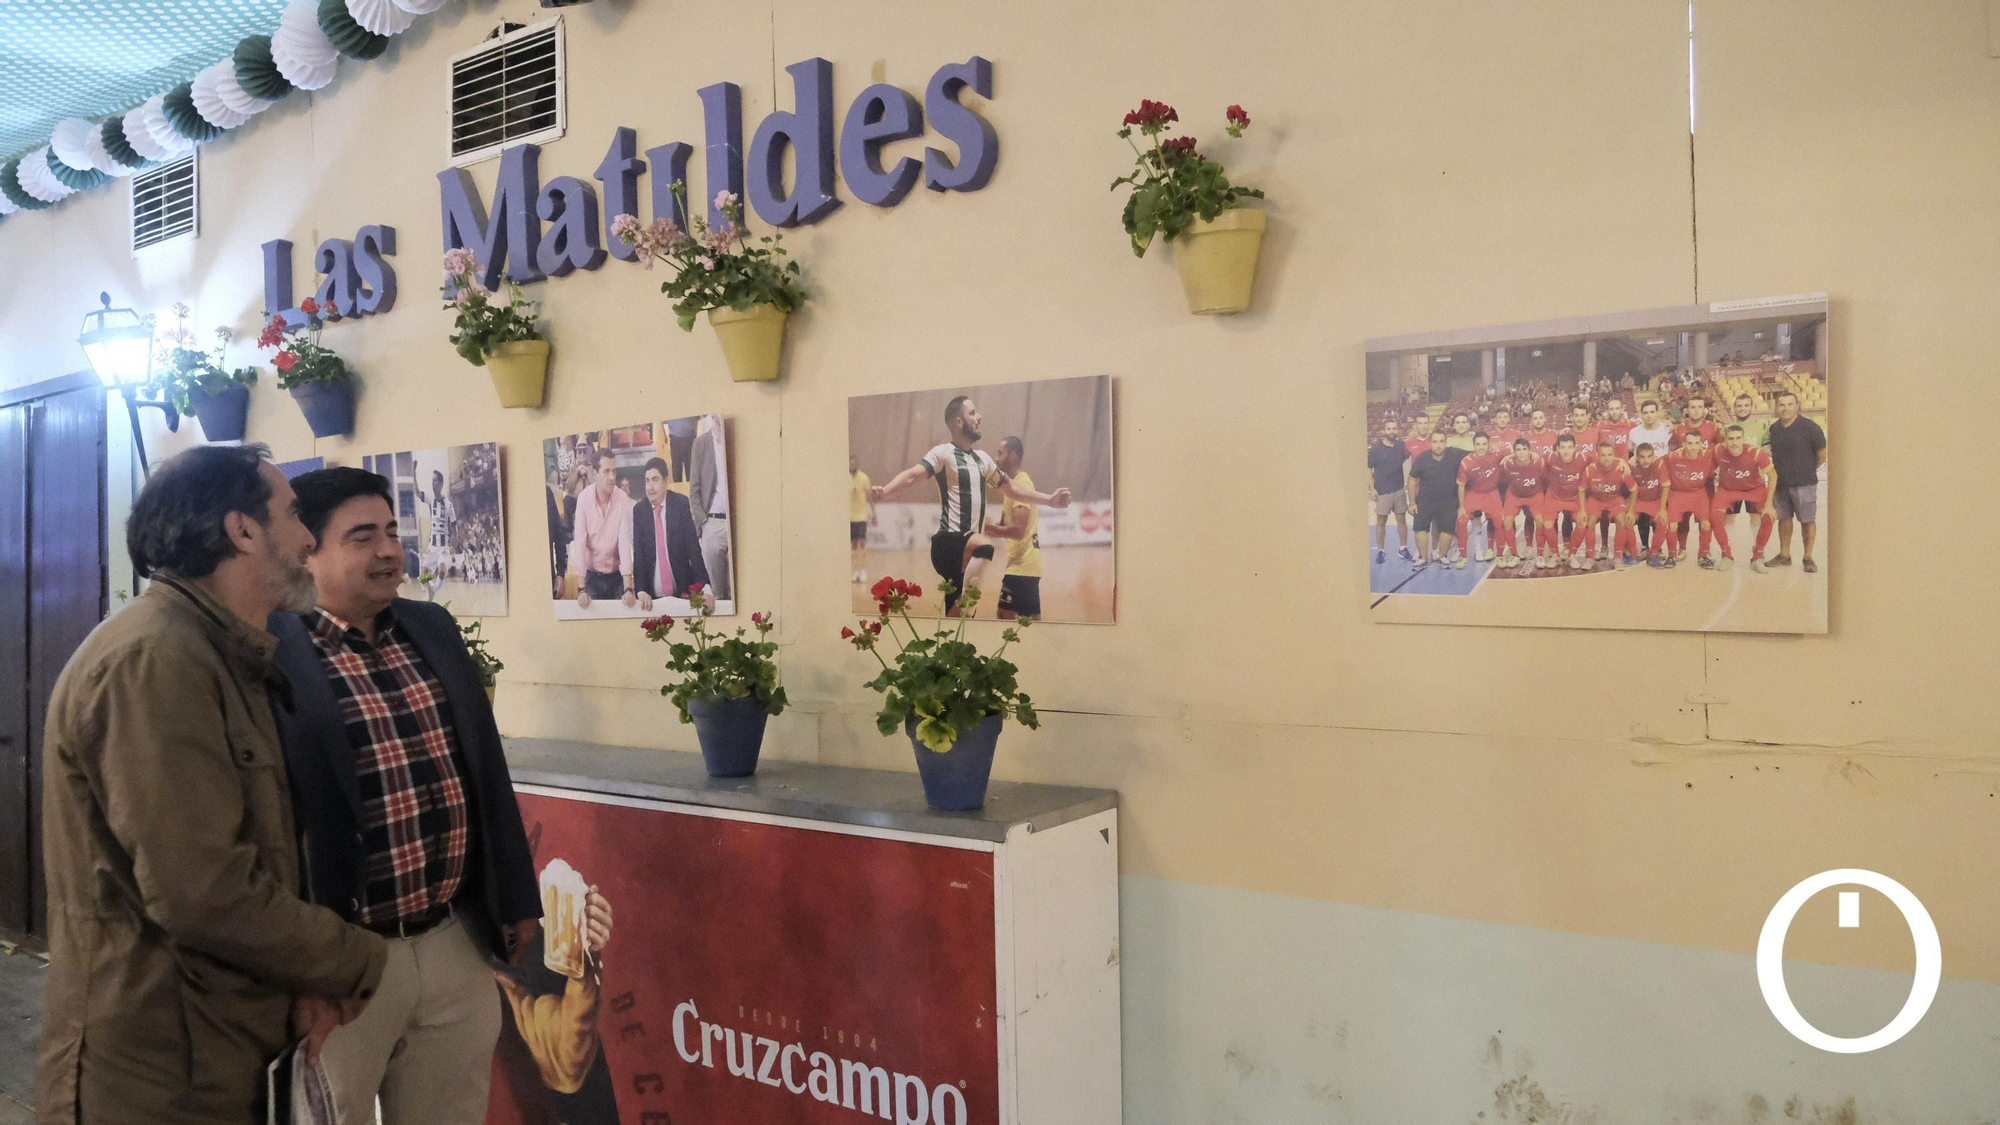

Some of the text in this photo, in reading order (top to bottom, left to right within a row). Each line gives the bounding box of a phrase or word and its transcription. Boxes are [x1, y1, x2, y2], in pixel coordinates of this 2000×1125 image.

[261, 224, 397, 330] Las
[672, 998, 968, 1125] Cruzcampo
[738, 1005, 877, 1052] DESDE 1904
